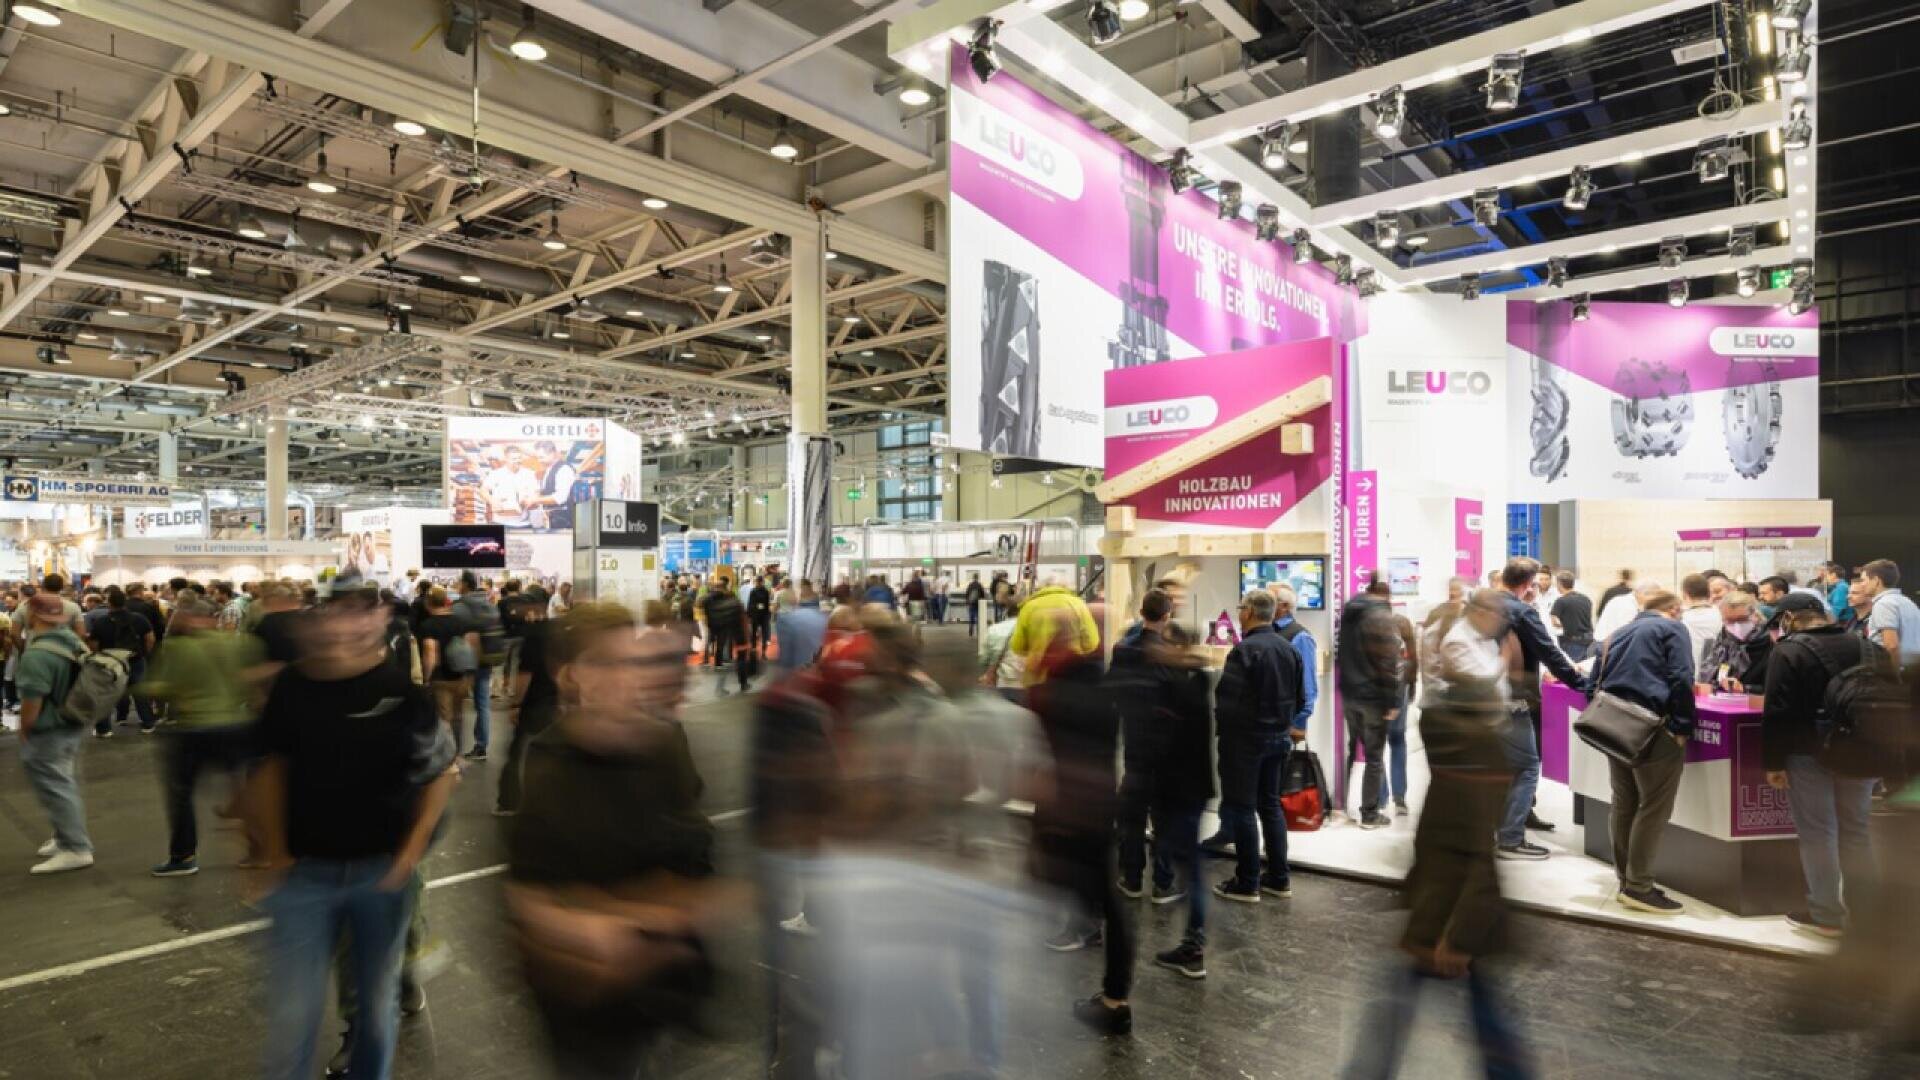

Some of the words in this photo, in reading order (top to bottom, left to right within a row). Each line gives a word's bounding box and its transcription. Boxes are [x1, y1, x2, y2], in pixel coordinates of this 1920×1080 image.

[979, 114, 1057, 177] LEUCO
[1174, 222, 1237, 279] UNSERE
[1733, 333, 1795, 349] LEUCO
[1387, 371, 1491, 395] LEUCO
[1127, 405, 1190, 427] LEUCO
[521, 424, 581, 436] OERTLI
[9, 482, 33, 495] HM
[41, 481, 144, 495] HM-SPOERRI
[148, 485, 169, 496] AG
[1179, 475, 1252, 493] HOLZBAU
[1334, 422, 1342, 565] INNOVATIONEN
[1165, 492, 1281, 513] INNOVATIONEN
[148, 510, 201, 527] FELDER
[606, 513, 623, 528] 1.0
[629, 520, 647, 532] Info
[1354, 495, 1371, 548] TÜREN
[600, 559, 618, 570] 1.0
